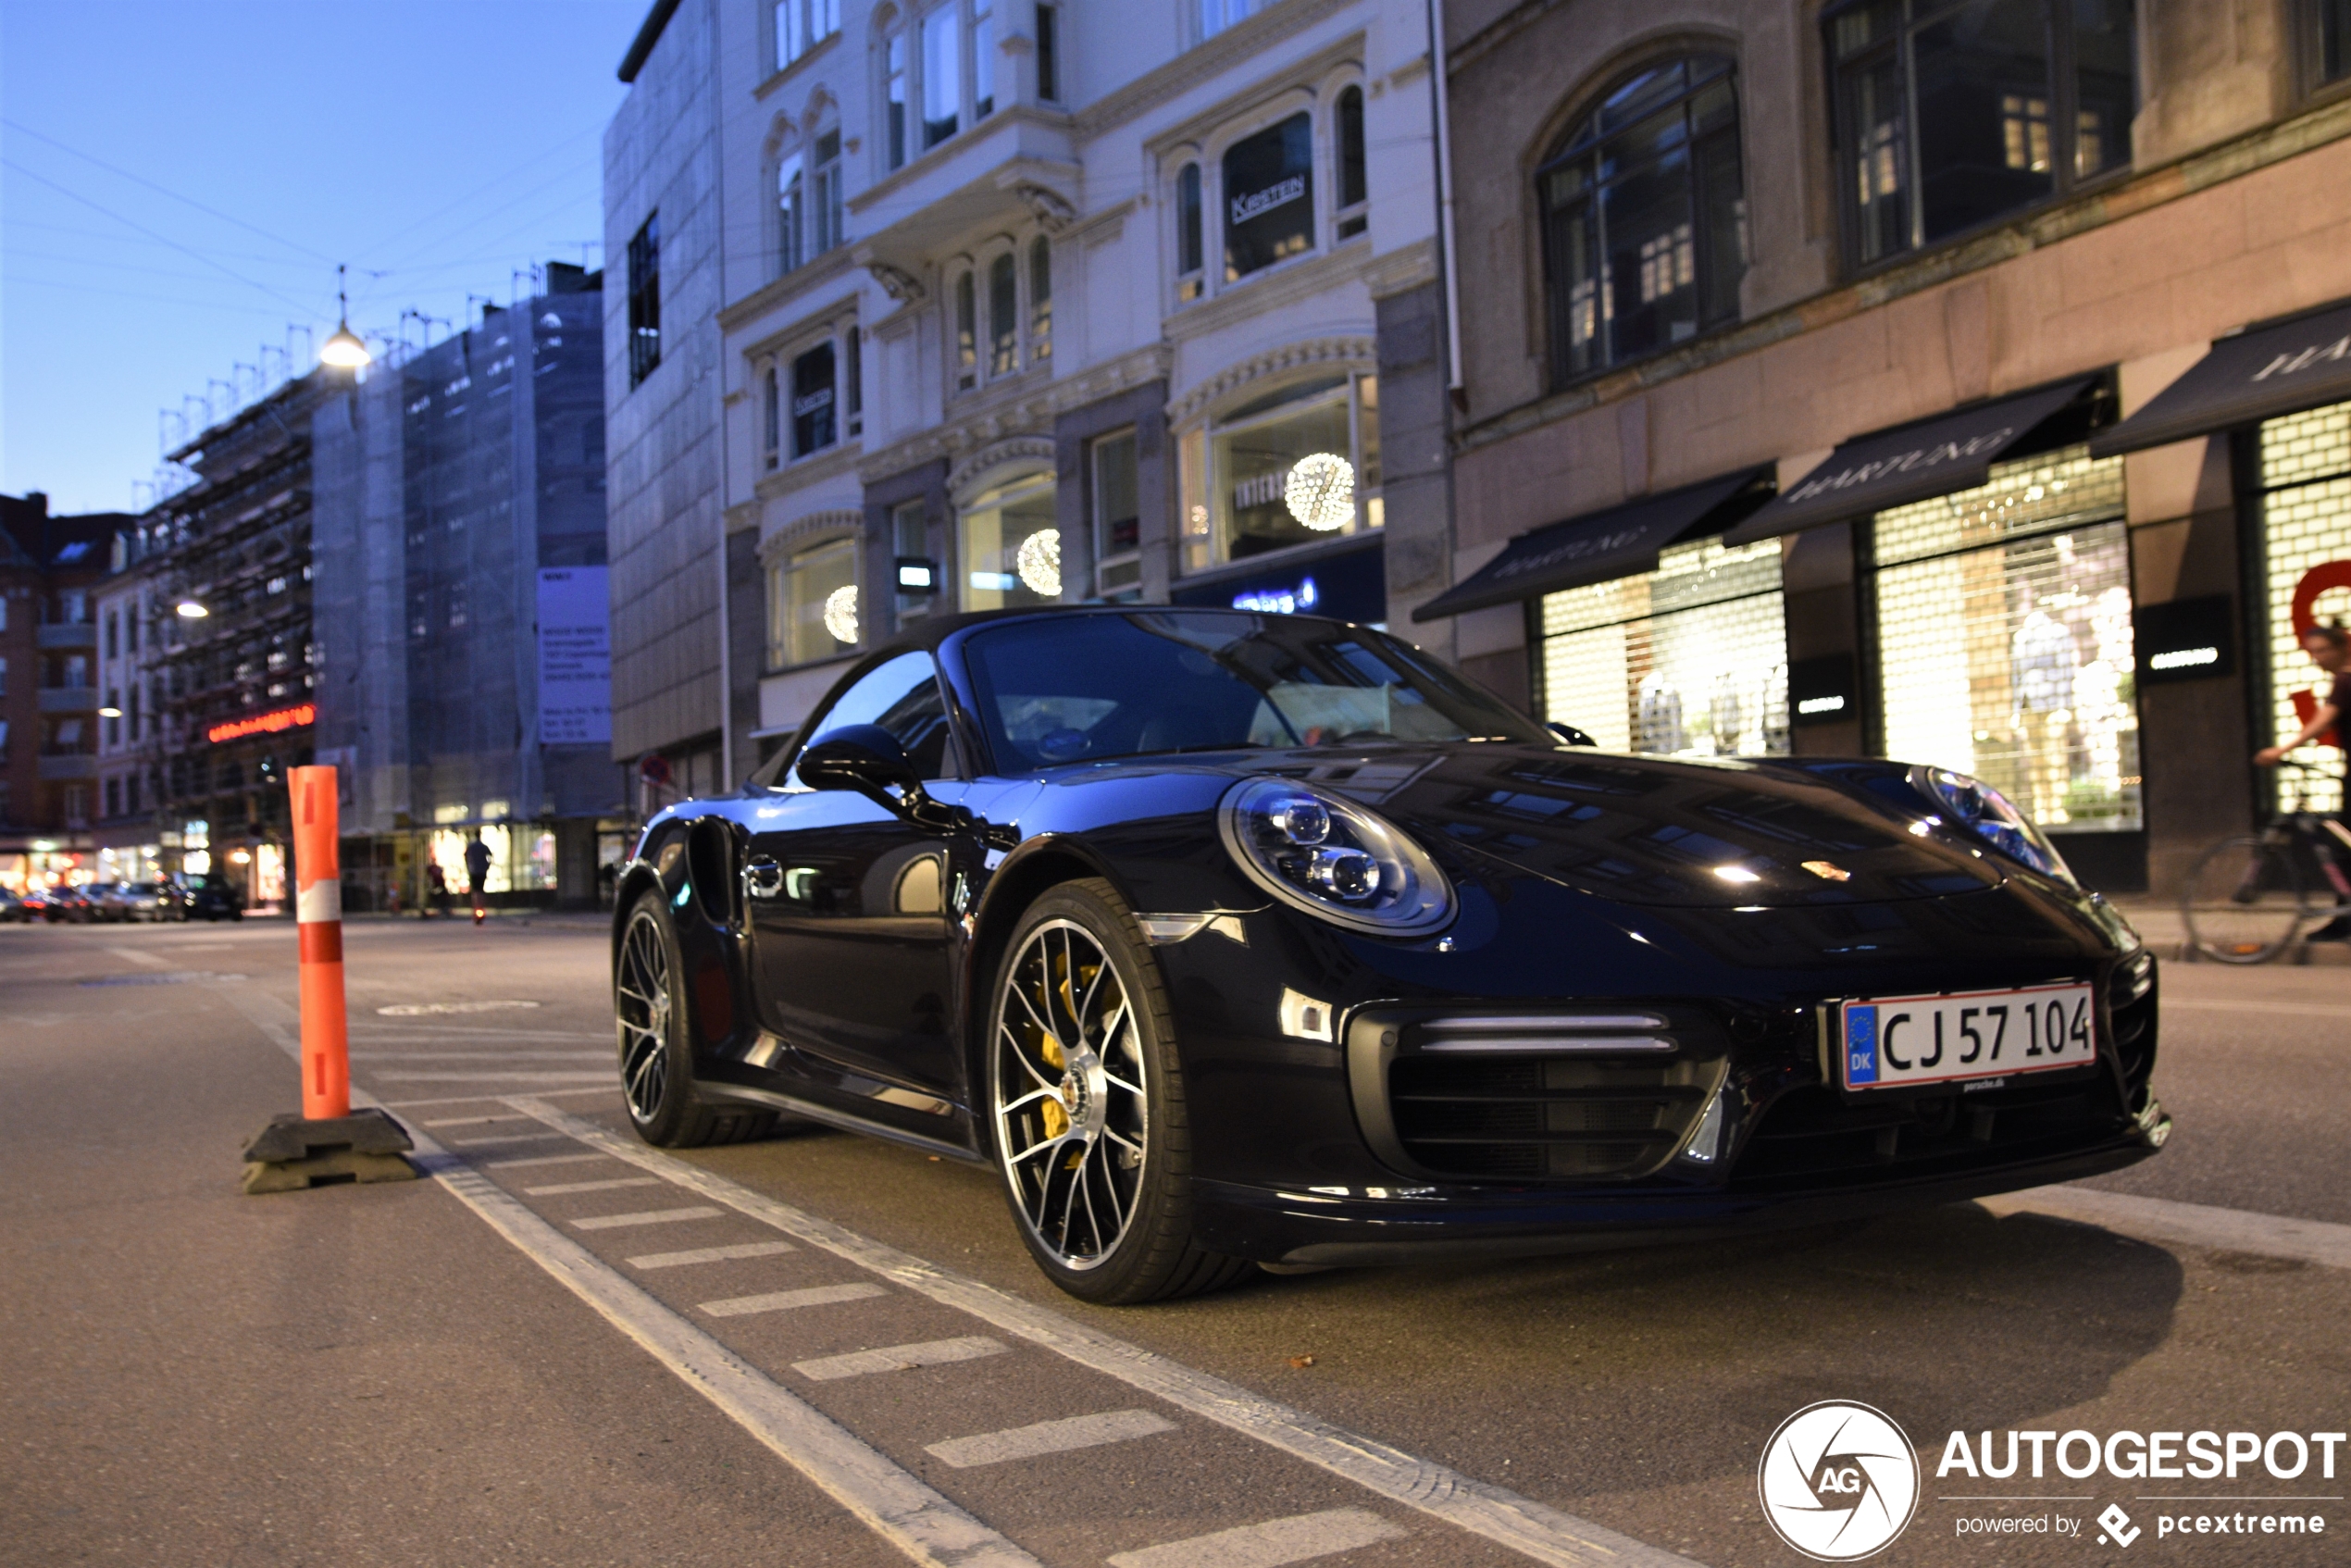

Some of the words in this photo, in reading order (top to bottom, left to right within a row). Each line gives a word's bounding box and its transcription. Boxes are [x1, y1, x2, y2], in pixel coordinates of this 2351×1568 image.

[1788, 427, 2014, 503] HARTUNG
[1851, 1052, 1872, 1070] DK
[1883, 1011, 1943, 1071] CJ
[1959, 1005, 2009, 1064] 57
[2024, 996, 2088, 1057] 104
